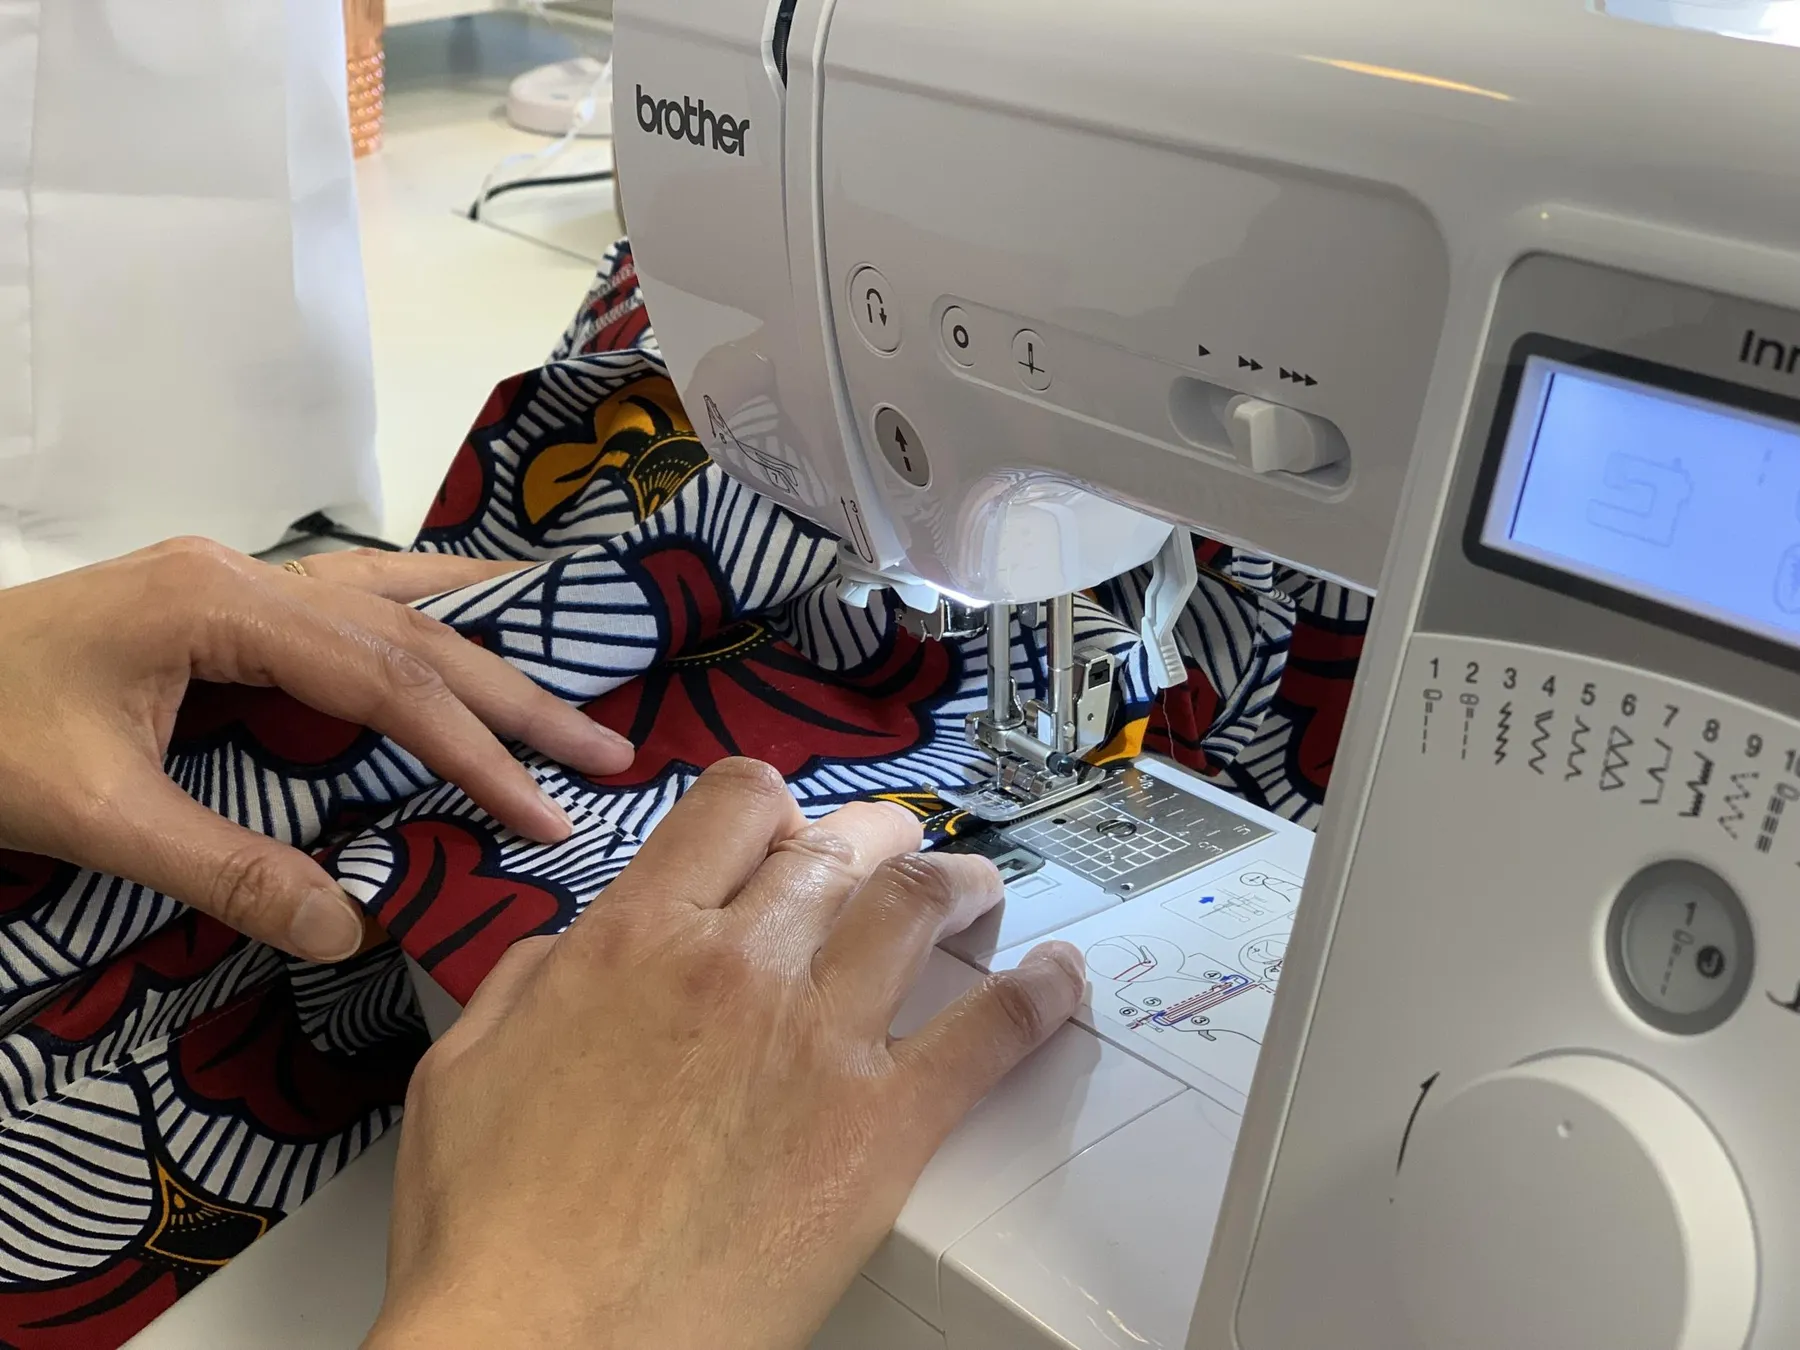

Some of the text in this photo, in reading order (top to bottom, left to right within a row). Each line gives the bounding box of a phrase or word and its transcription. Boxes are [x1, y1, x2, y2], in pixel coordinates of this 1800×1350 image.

[635, 84, 750, 157] brother
[850, 500, 858, 513] 3
[1429, 657, 1440, 679] 1
[1465, 661, 1479, 684] 2
[1503, 667, 1517, 690] 3
[1542, 675, 1557, 698] 4
[1581, 683, 1596, 706] 5
[1620, 693, 1637, 717] 6
[1662, 704, 1679, 728] 7
[1702, 718, 1720, 743] 8
[1745, 733, 1763, 758] 9
[1232, 823, 1251, 836] in
[1198, 841, 1224, 854] cm
